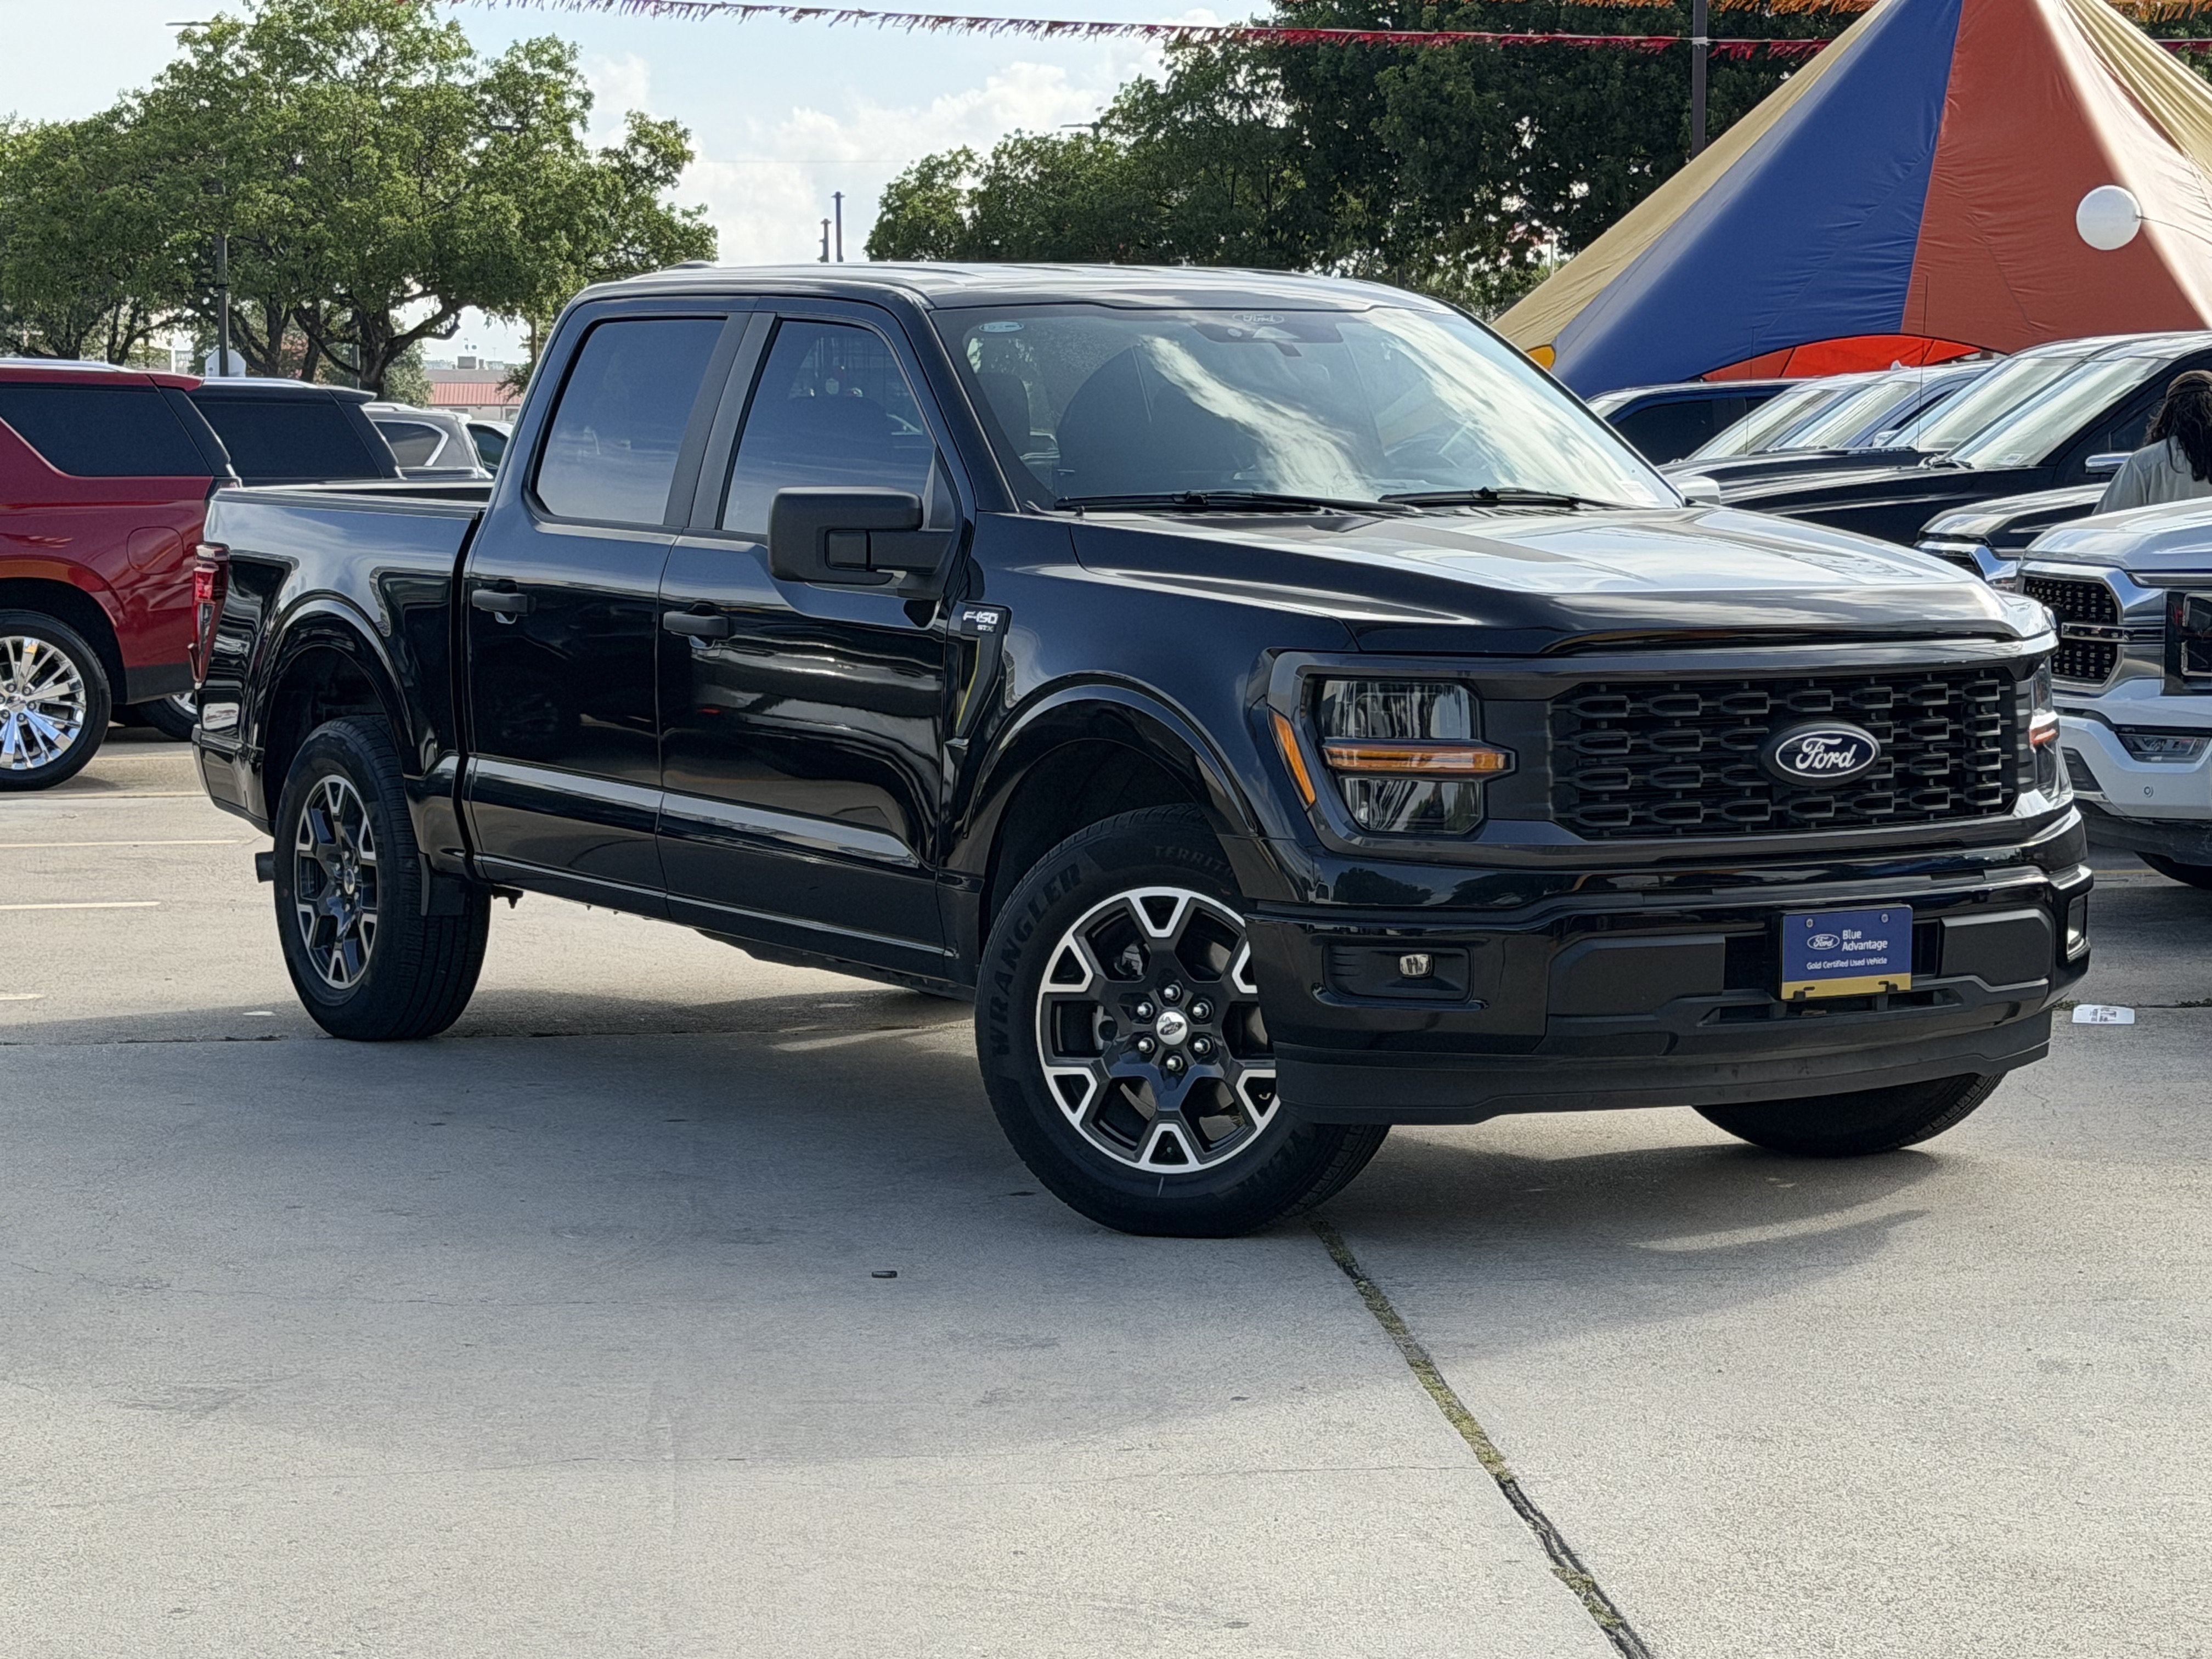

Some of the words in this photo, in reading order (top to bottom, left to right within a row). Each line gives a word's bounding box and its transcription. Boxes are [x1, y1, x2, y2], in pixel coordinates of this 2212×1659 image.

[963, 611, 998, 624] F-150
[1796, 738, 1857, 769] Ford
[1842, 929, 1861, 940] Blue
[1813, 936, 1834, 947] Ford
[1842, 940, 1888, 951] Advantage
[990, 863, 1082, 1057] WRANGLER
[1807, 961, 1821, 970] Gold
[1823, 960, 1848, 969] Certified
[1866, 957, 1887, 966] Vehicle
